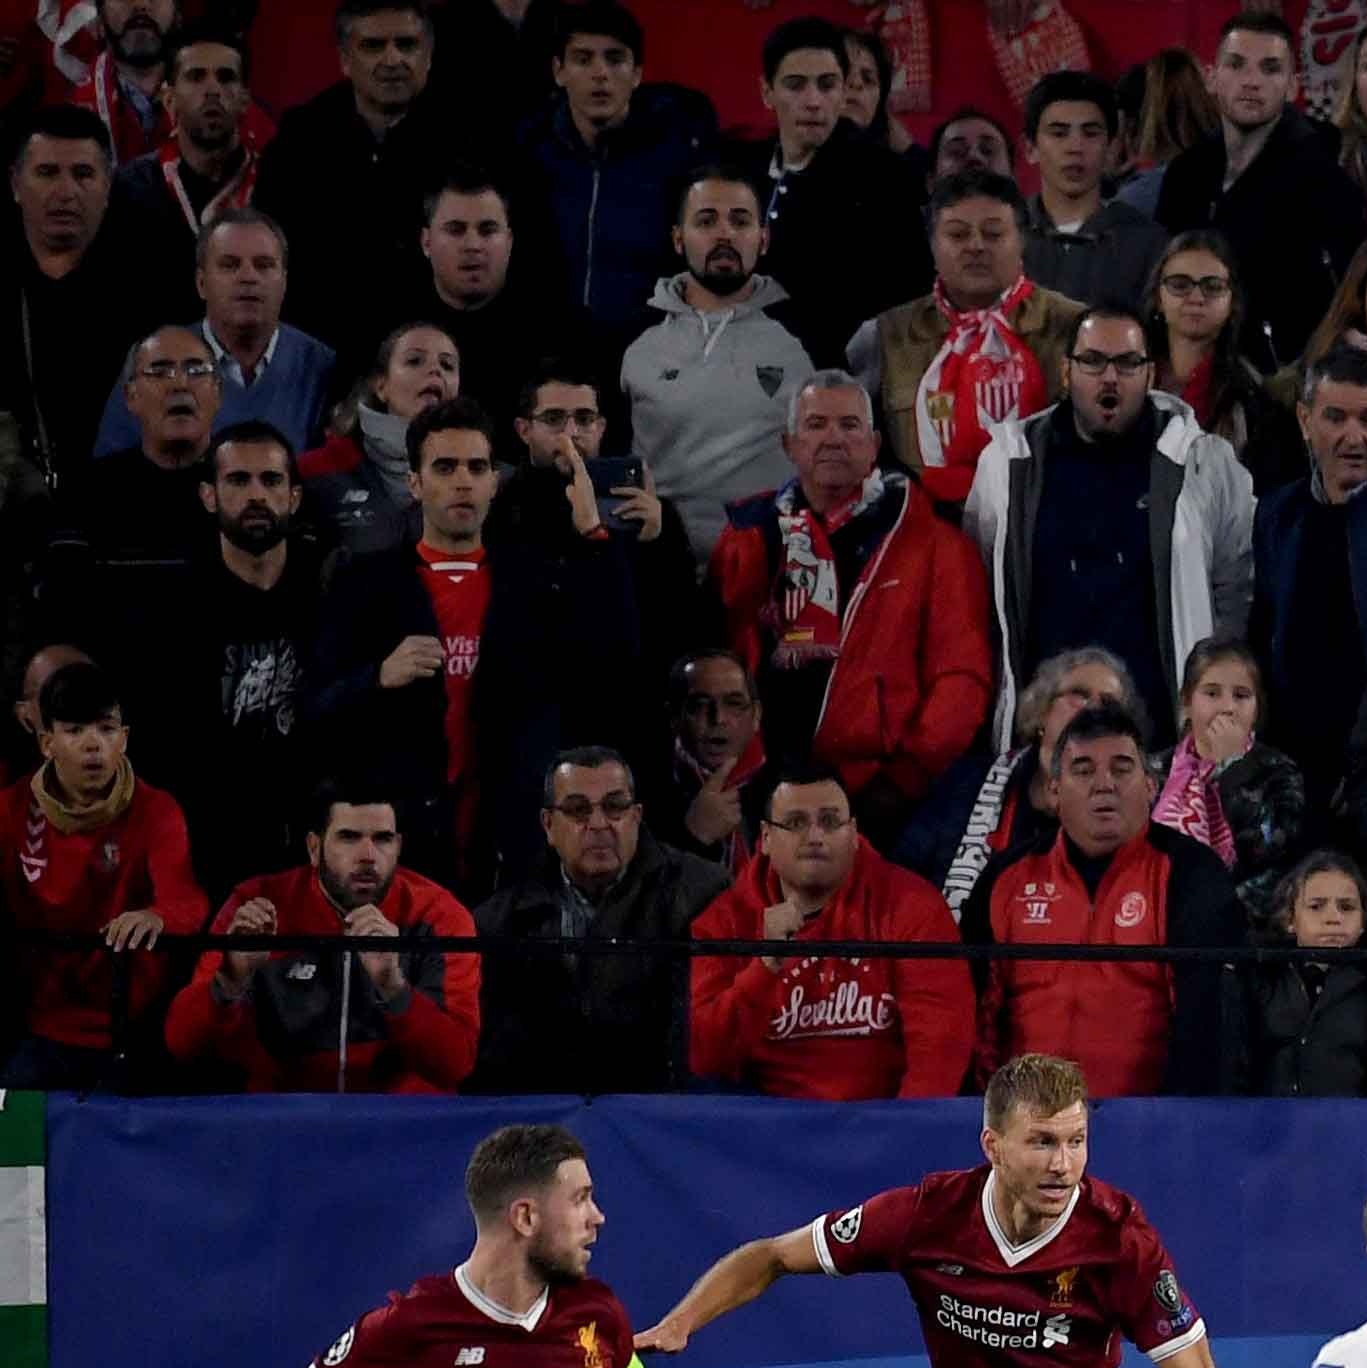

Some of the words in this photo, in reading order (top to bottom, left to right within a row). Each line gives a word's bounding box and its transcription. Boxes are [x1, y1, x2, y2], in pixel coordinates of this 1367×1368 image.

[769, 980, 897, 1039] Sevilla
[936, 1309, 1038, 1349] Chartered
[939, 1294, 1041, 1328] Standard
